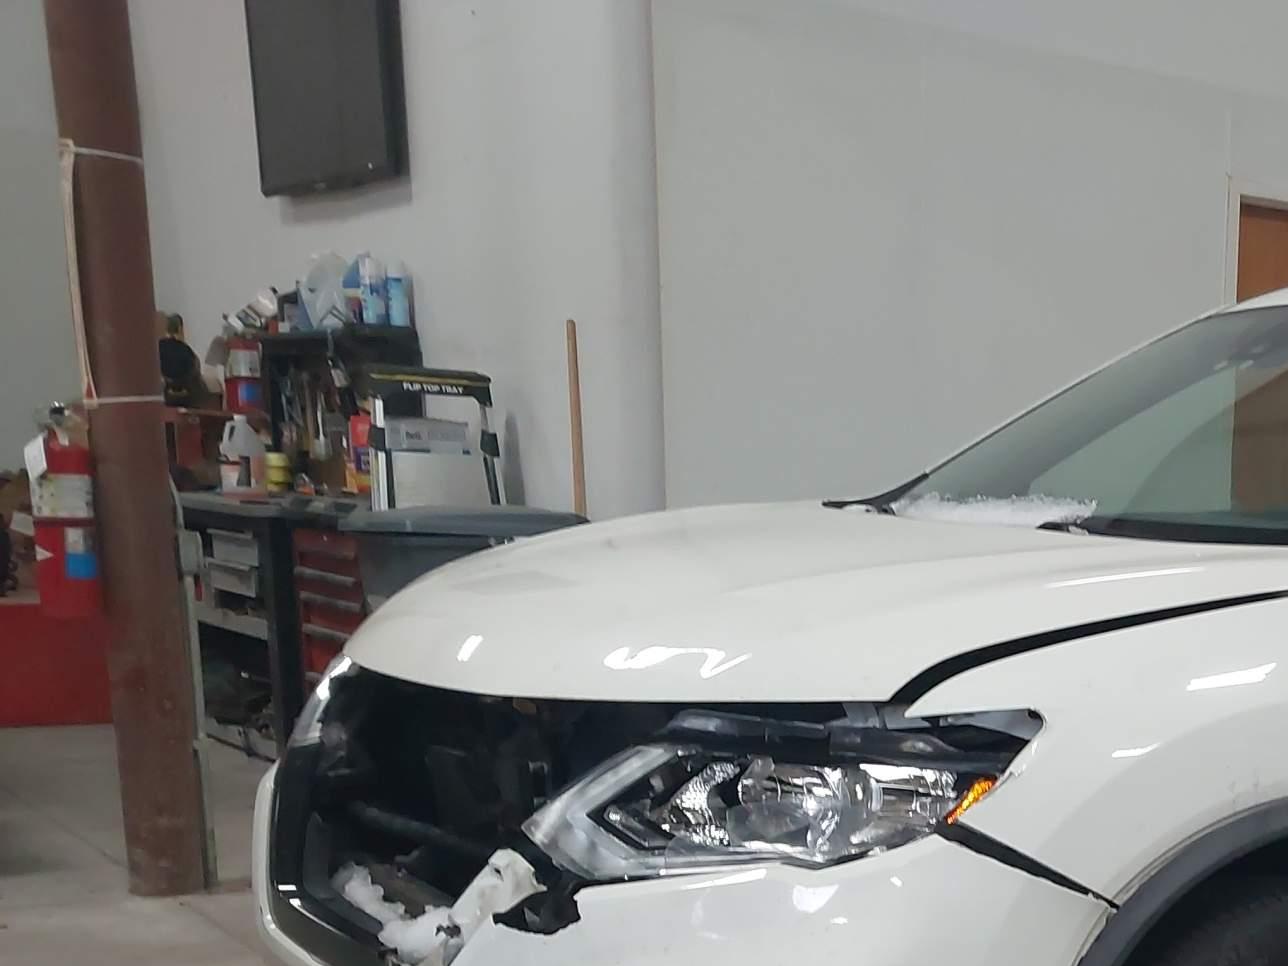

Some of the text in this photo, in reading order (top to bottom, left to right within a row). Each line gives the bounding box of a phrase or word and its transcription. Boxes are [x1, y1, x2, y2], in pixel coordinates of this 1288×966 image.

[402, 381, 464, 394] FLIP TOP TRAY
